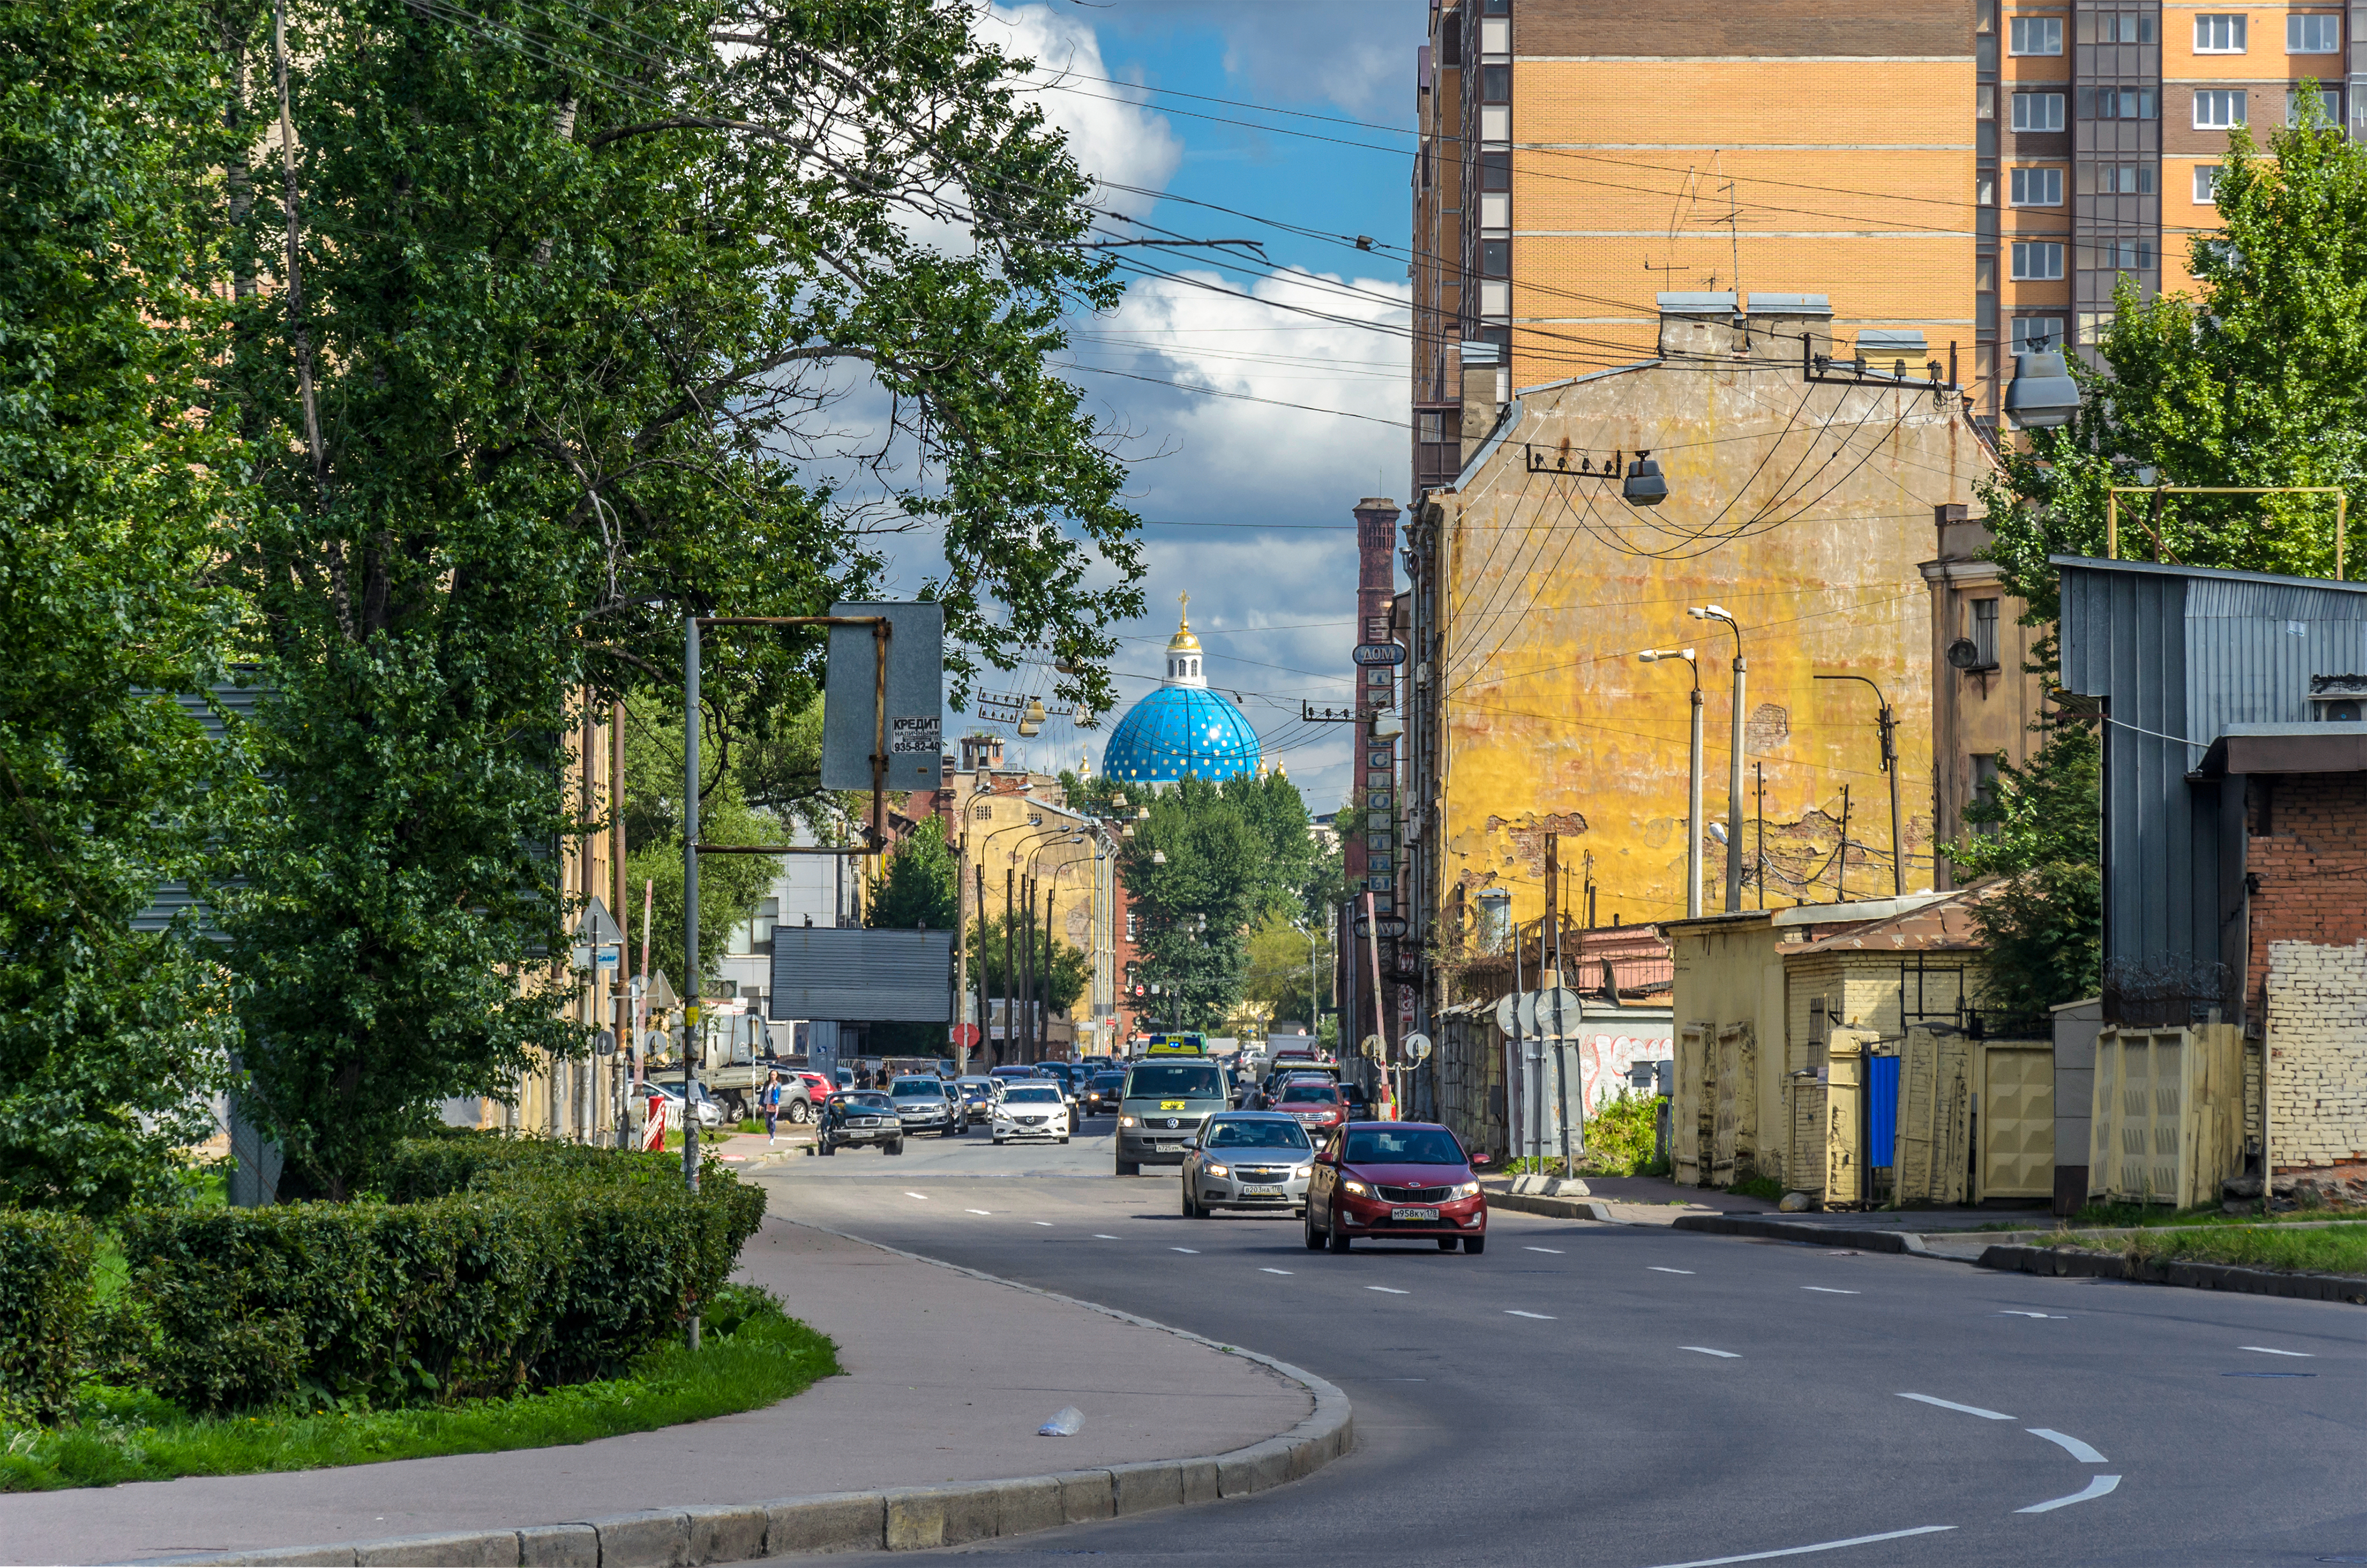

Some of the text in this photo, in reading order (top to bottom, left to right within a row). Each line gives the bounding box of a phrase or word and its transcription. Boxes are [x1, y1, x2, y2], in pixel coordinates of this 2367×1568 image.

[1363, 647, 1394, 662] ДОМ
[894, 718, 939, 731] КРЕДИТ
[894, 741, 939, 752] 935-82-40
[1359, 922, 1400, 935] УЛУГ
